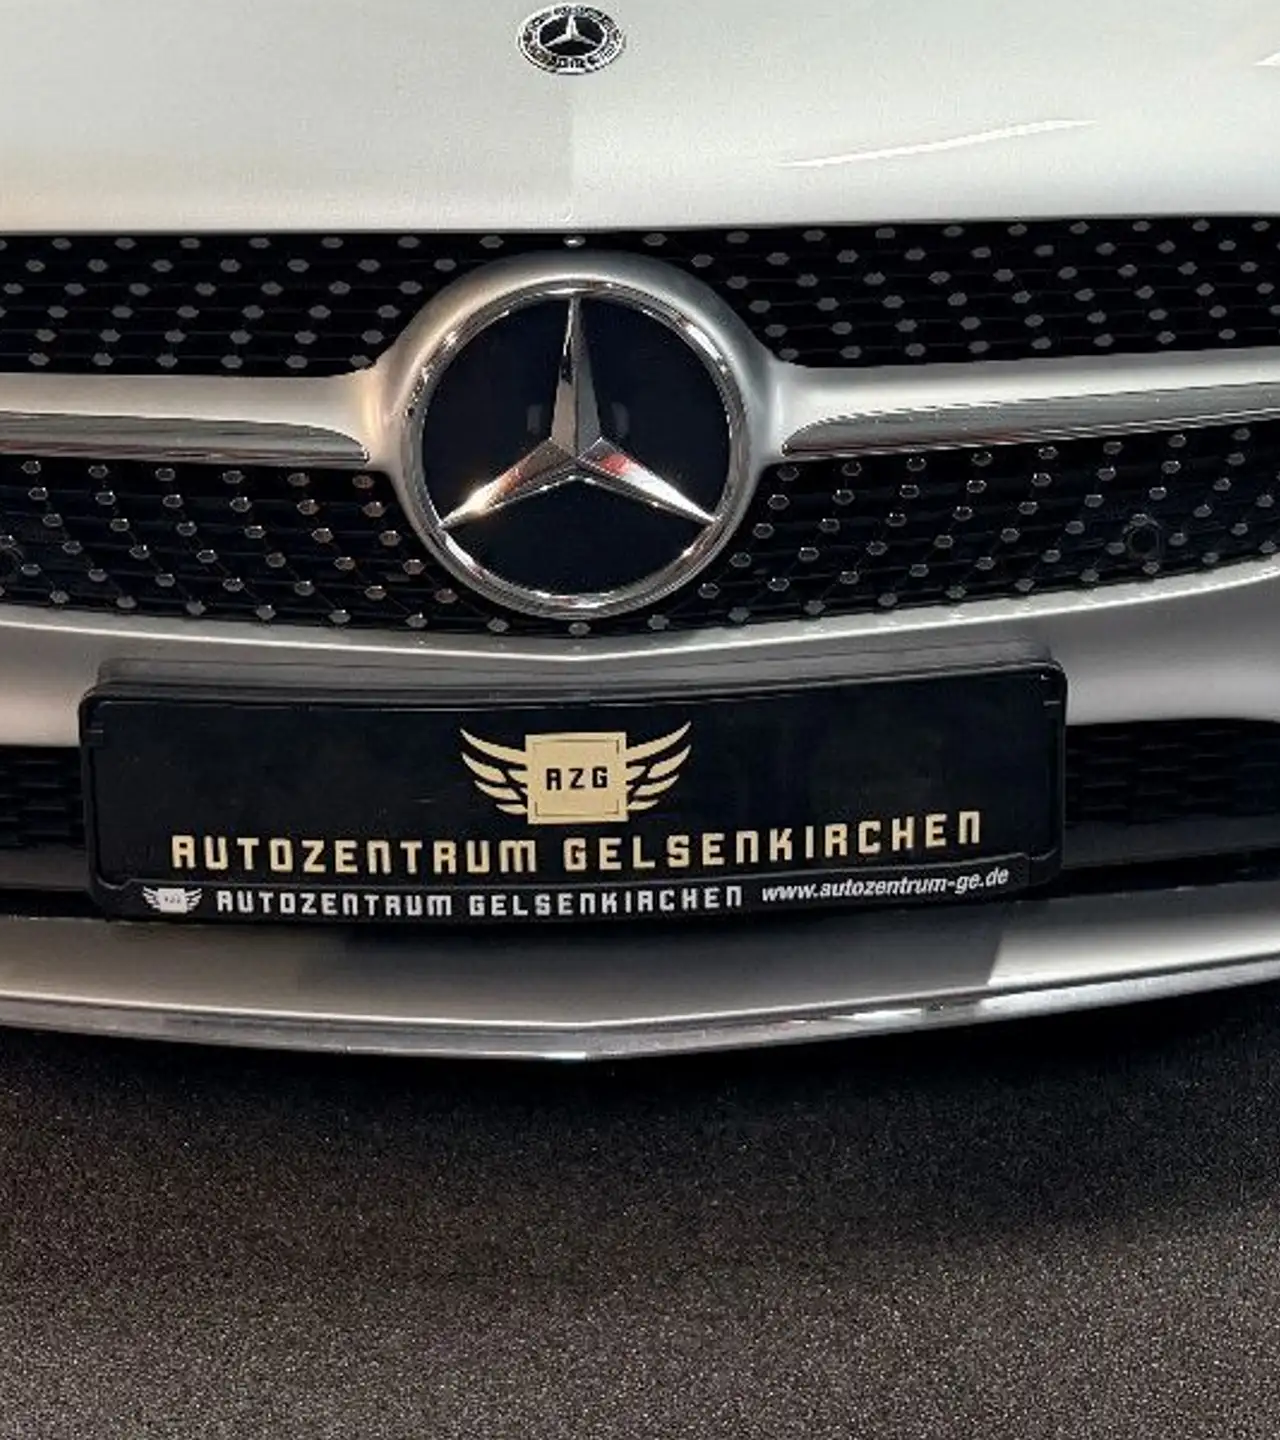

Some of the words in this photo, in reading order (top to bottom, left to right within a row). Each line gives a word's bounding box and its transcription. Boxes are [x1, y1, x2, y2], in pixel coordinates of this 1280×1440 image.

[545, 766, 609, 791] AZG
[171, 834, 537, 874] AUTOZENTRUM
[563, 810, 981, 872] GELSENKIRCHEN
[216, 889, 453, 918] AUTOZENTRUM
[469, 885, 743, 918] GELSENKIRCHEN
[760, 866, 1010, 902] www.autozentrum-ge.de
